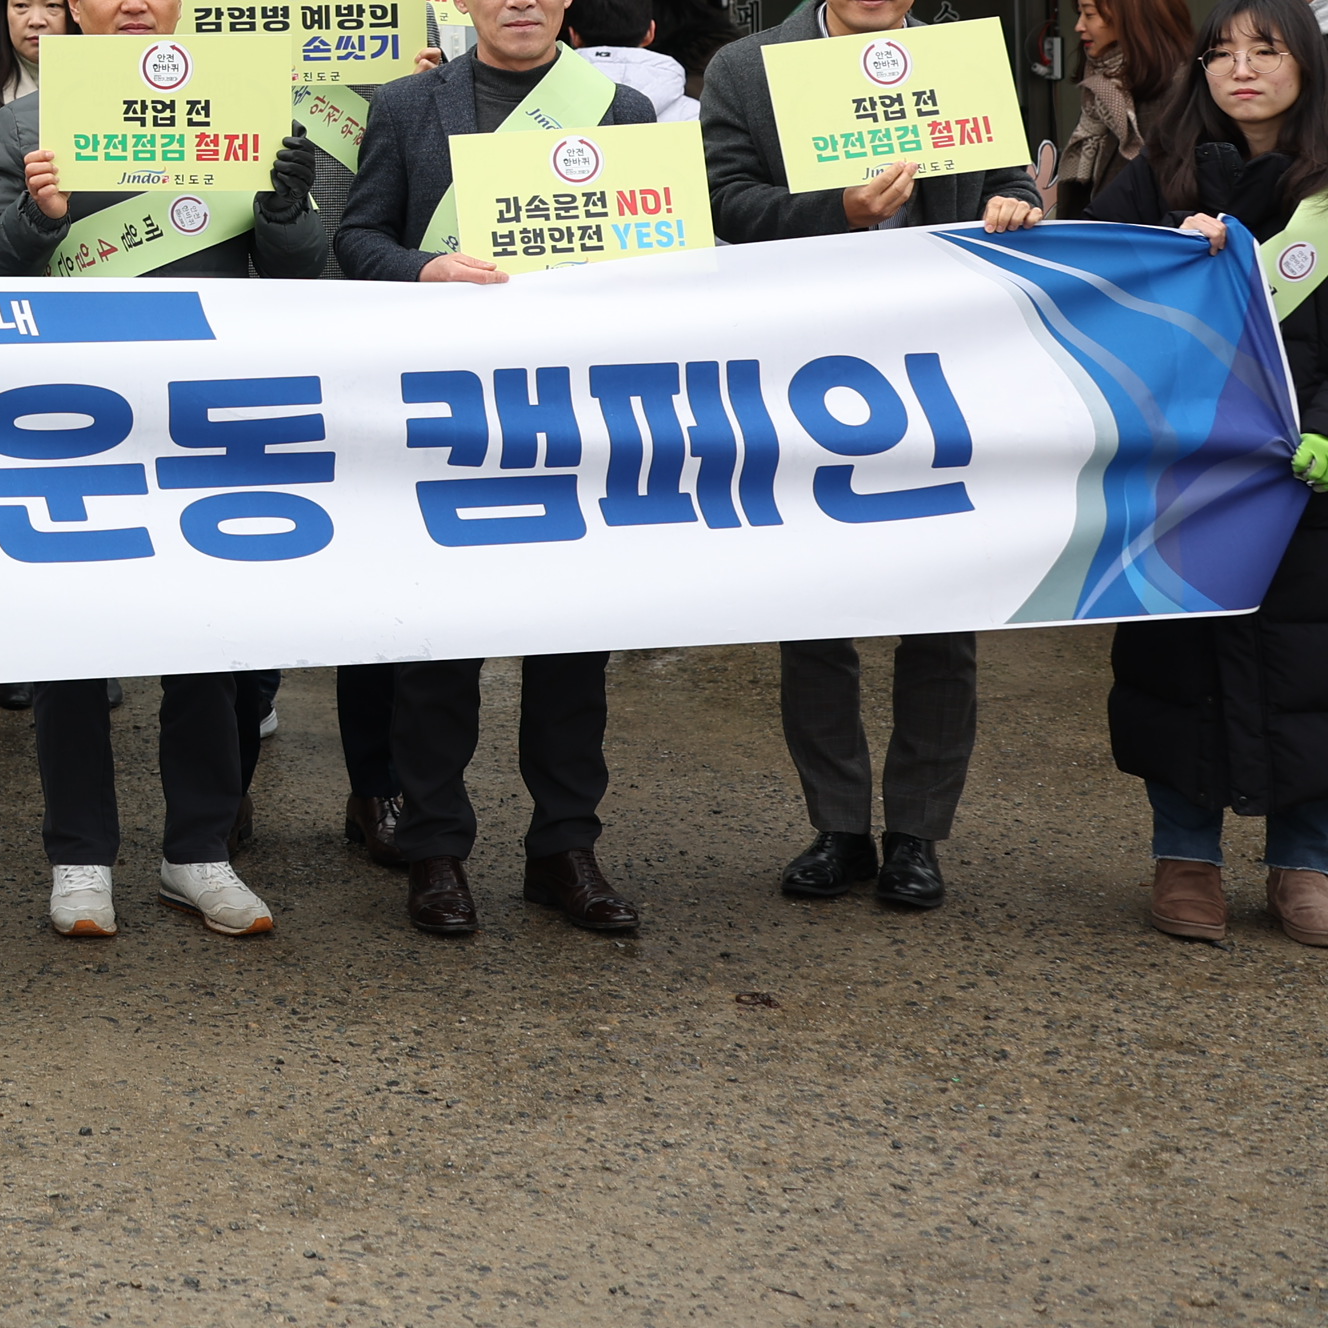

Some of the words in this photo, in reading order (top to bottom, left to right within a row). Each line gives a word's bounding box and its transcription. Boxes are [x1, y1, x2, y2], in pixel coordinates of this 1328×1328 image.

[193, 6, 290, 33] 감염병
[301, 3, 399, 30] 예방의
[157, 54, 175, 63] 안전
[302, 34, 400, 61] 손씻기
[875, 50, 893, 59] 안전
[153, 63, 179, 73] 한바퀴
[873, 58, 900, 69] 한바퀴
[123, 99, 176, 127] 작업
[186, 99, 211, 127] 전
[851, 93, 907, 123] 작업
[912, 89, 940, 116] 전
[73, 133, 185, 161] 안전점검
[195, 132, 259, 161] 철저!
[566, 147, 584, 157] 안전
[812, 124, 923, 162] 안전점검
[927, 116, 994, 149] 철저!
[563, 156, 590, 167] 한바퀴
[117, 172, 161, 185] Jindo
[495, 190, 608, 224] 과속운전
[616, 187, 673, 217] NO!
[491, 224, 605, 257] 보행안전
[611, 219, 686, 250] YES!
[401, 353, 975, 547] 캠페인
